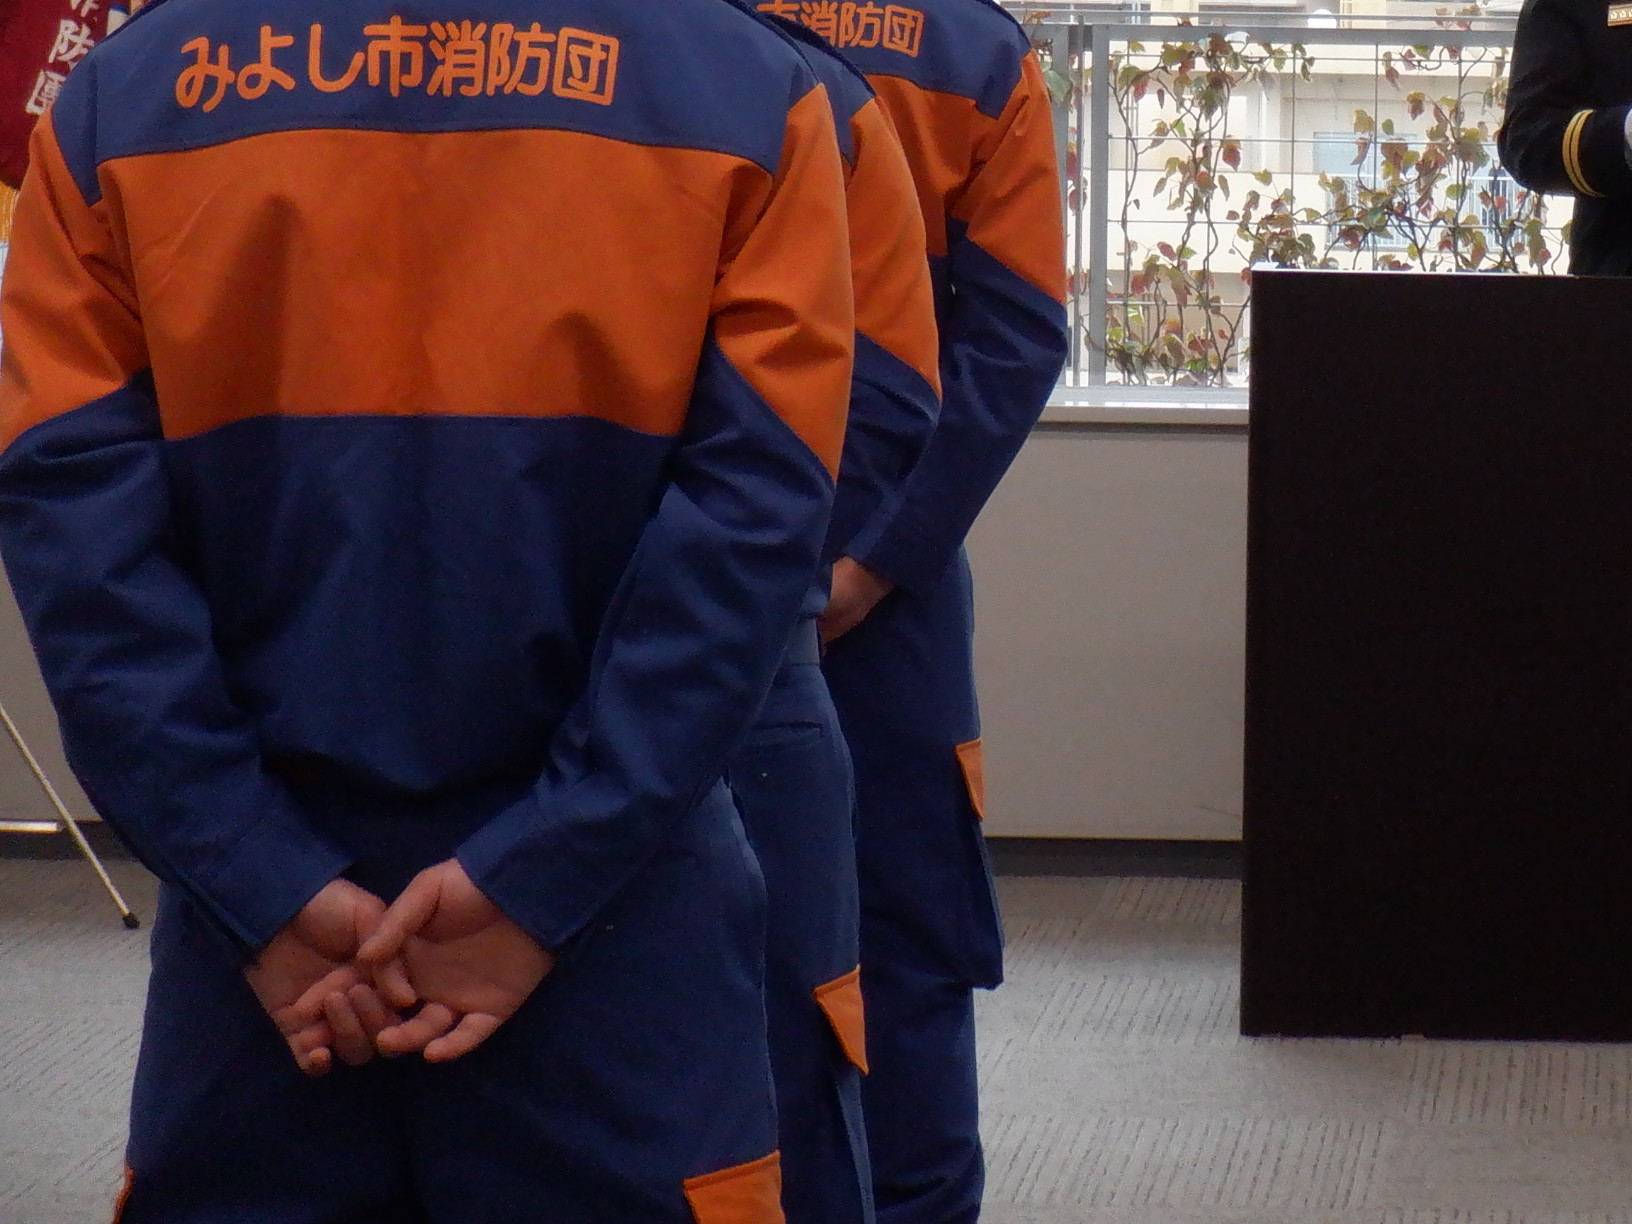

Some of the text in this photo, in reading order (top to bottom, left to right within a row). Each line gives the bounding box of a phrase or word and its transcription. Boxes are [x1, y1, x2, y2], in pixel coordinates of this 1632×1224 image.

[175, 14, 621, 114] みよし市消防団
